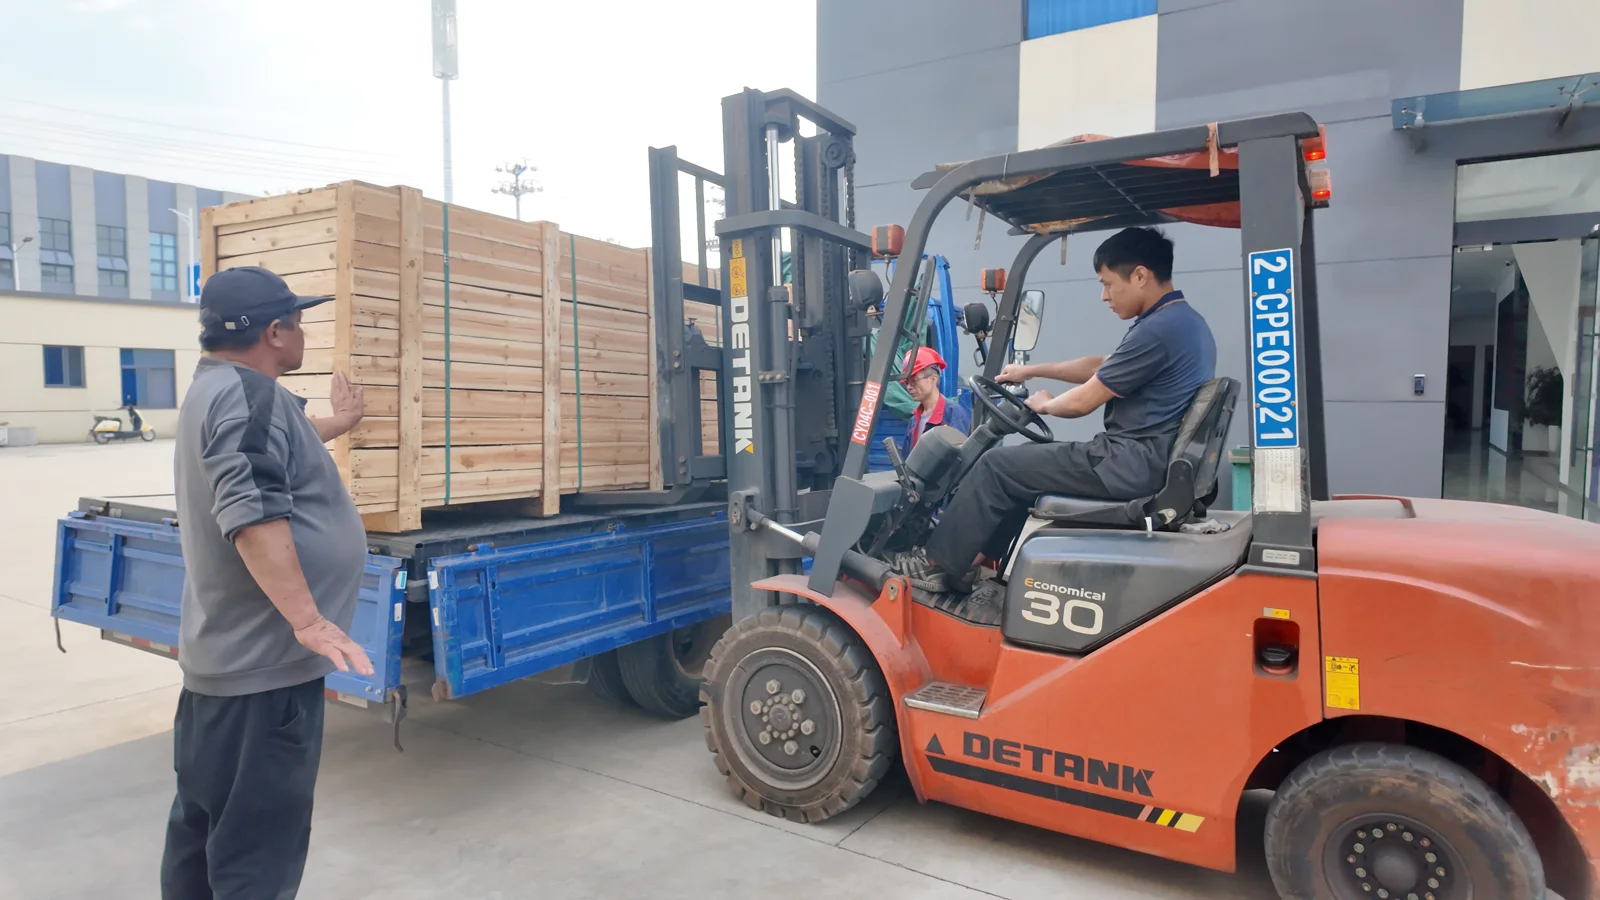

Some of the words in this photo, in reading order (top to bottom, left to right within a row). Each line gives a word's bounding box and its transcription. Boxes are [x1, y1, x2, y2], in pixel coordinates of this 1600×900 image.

[730, 297, 754, 455] DETANK
[1254, 256, 1294, 440] 2-CPE00021
[853, 383, 881, 441] CY04C-001
[1021, 590, 1104, 635] 30
[1024, 577, 1106, 602] Economical
[963, 731, 1155, 798] DETANK
